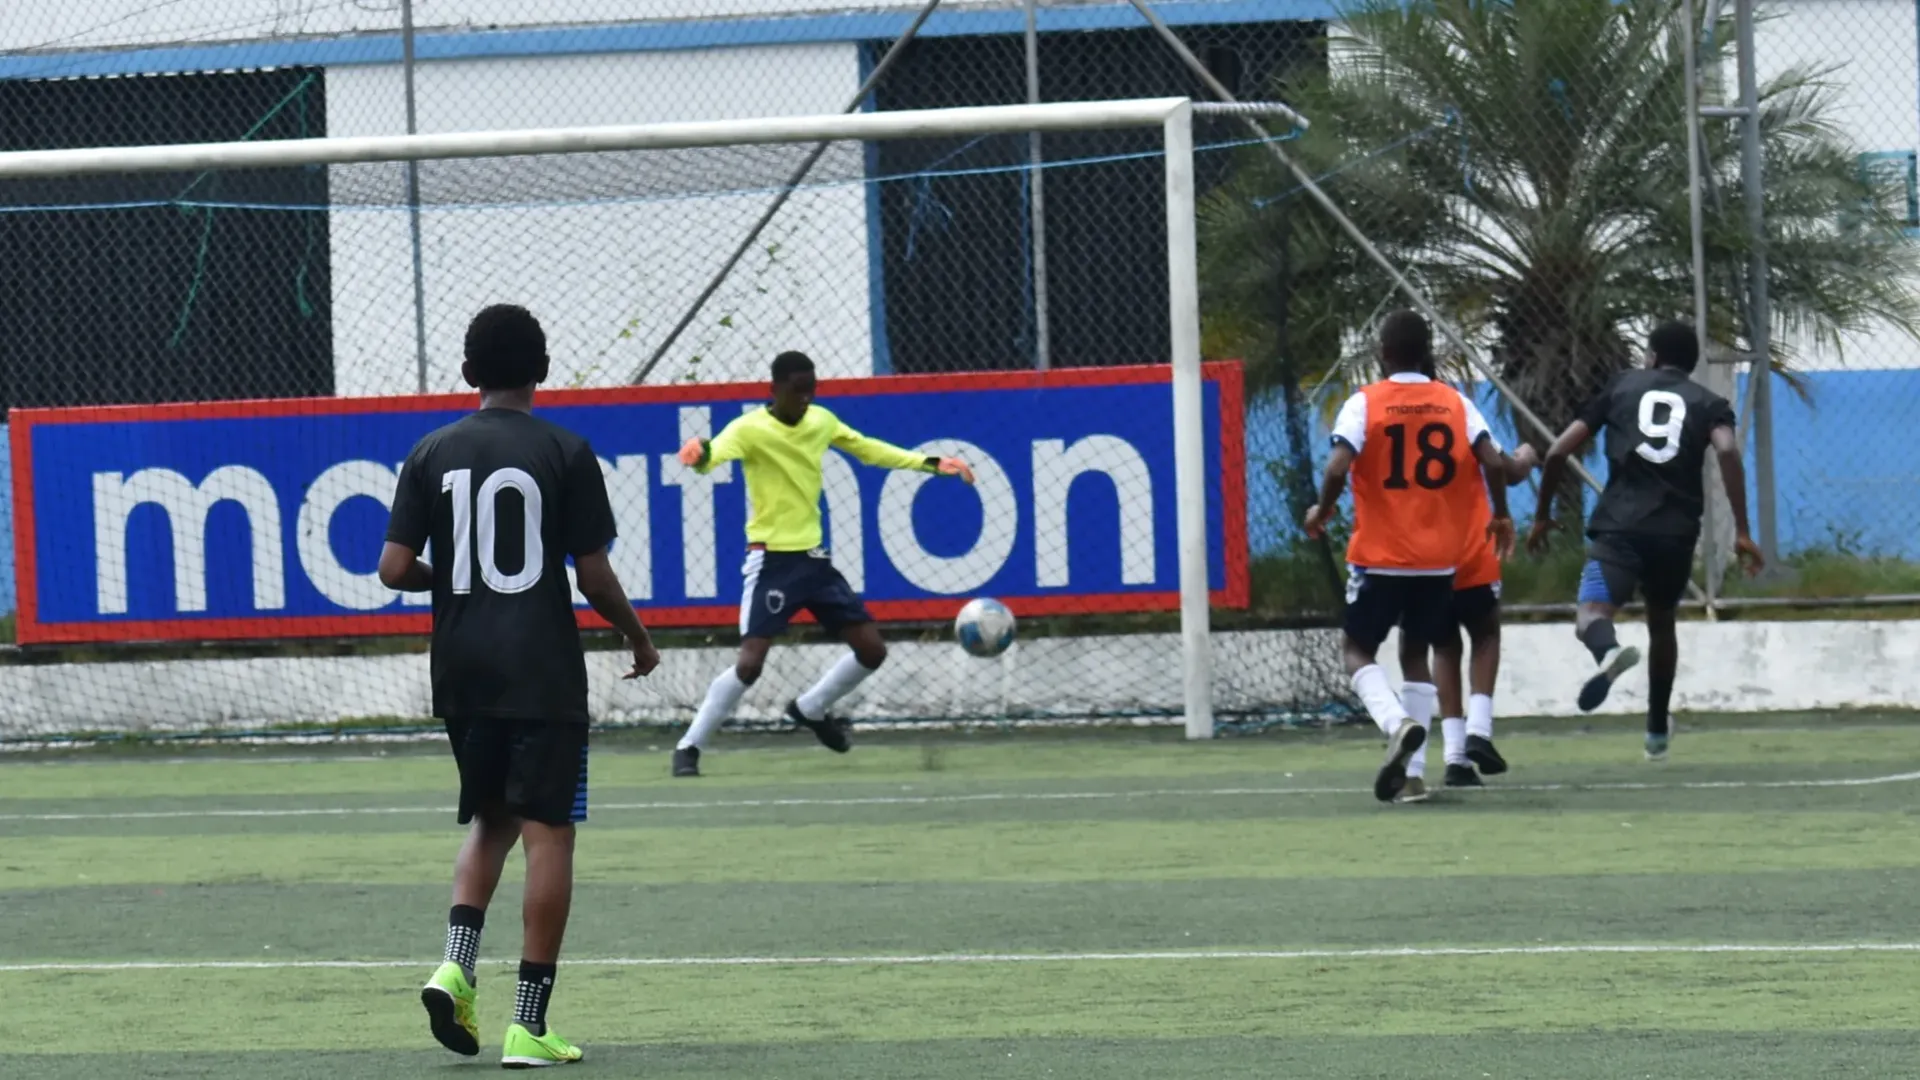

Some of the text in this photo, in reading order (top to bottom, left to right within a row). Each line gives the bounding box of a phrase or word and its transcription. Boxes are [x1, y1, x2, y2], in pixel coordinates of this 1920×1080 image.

[1383, 422, 1457, 490] 18
[1637, 389, 1687, 464] 9
[92, 405, 1156, 613] mathon
[442, 467, 543, 594] 10
